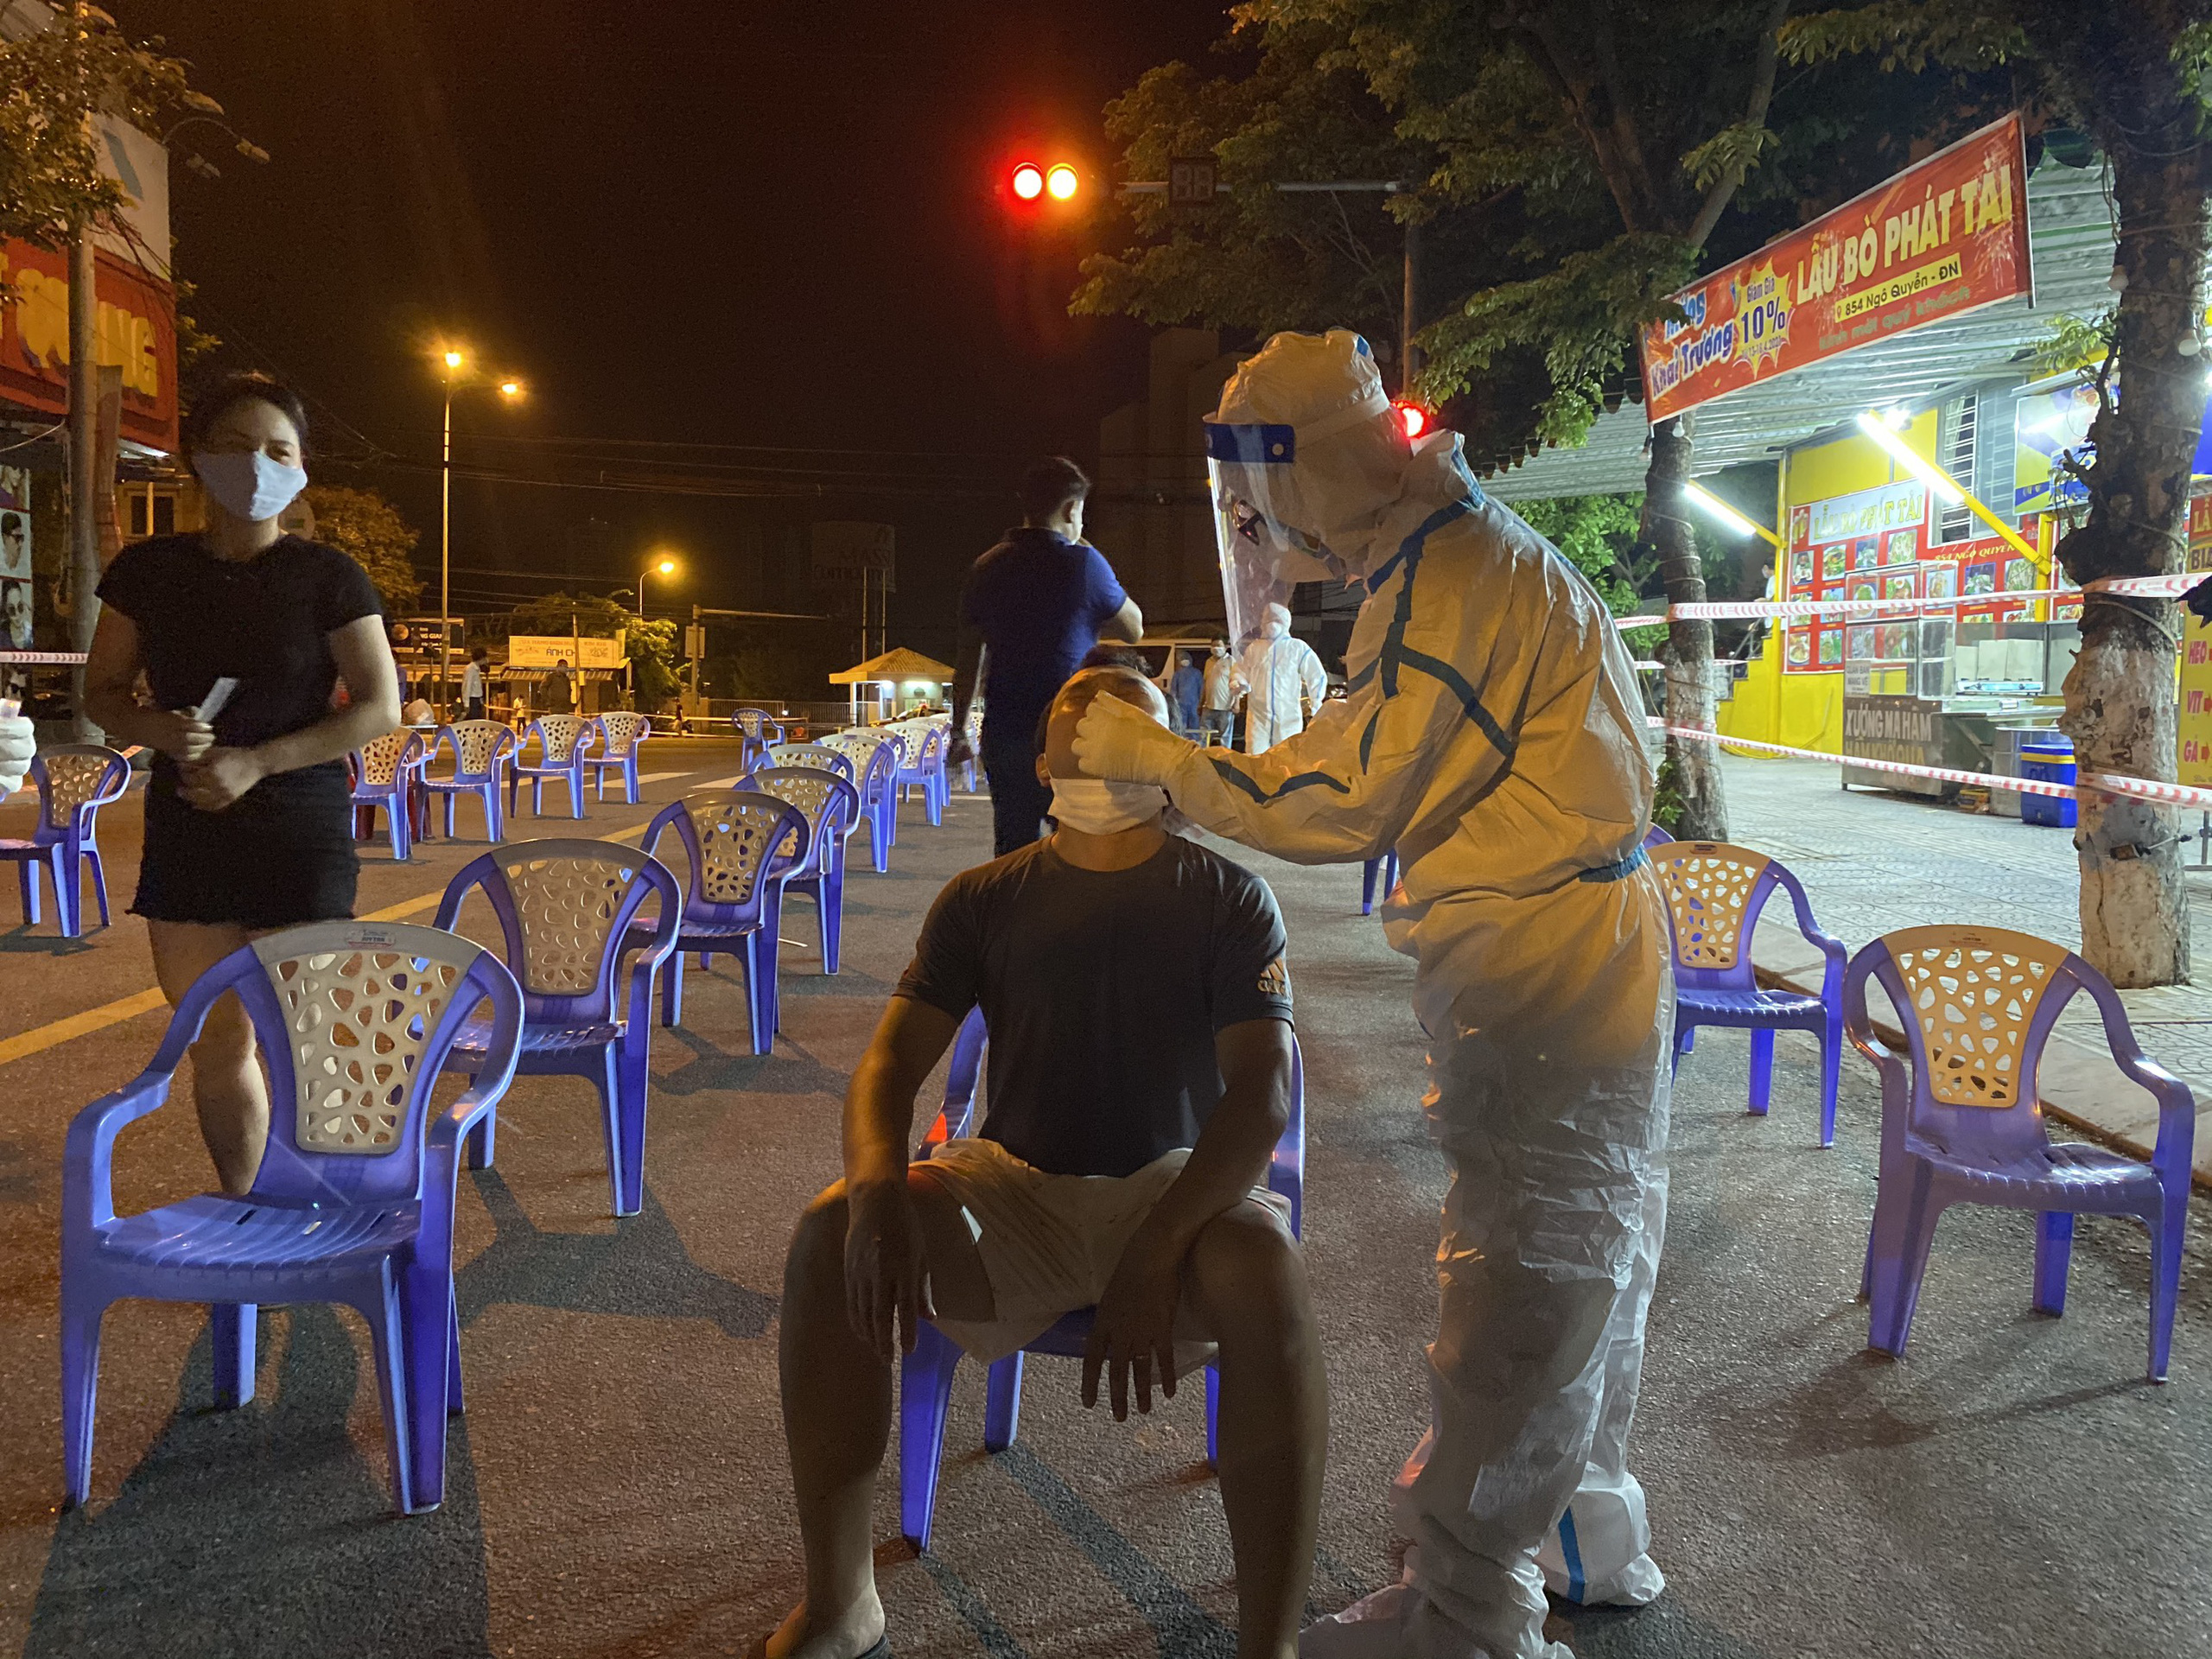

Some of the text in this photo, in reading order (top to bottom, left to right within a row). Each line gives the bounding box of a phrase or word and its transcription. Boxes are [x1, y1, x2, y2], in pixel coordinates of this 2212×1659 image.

[1843, 214, 1878, 286] BÒ
[1885, 184, 1955, 269] PHÁT
[1961, 158, 2012, 236] TÀI
[1845, 298, 1863, 316] 854
[1866, 288, 1887, 308] Ngô
[1939, 261, 1959, 281] ĐN
[1741, 296, 1785, 343] 10%
[1897, 489, 1923, 523] TÀI
[2188, 641, 2207, 664] HEO
